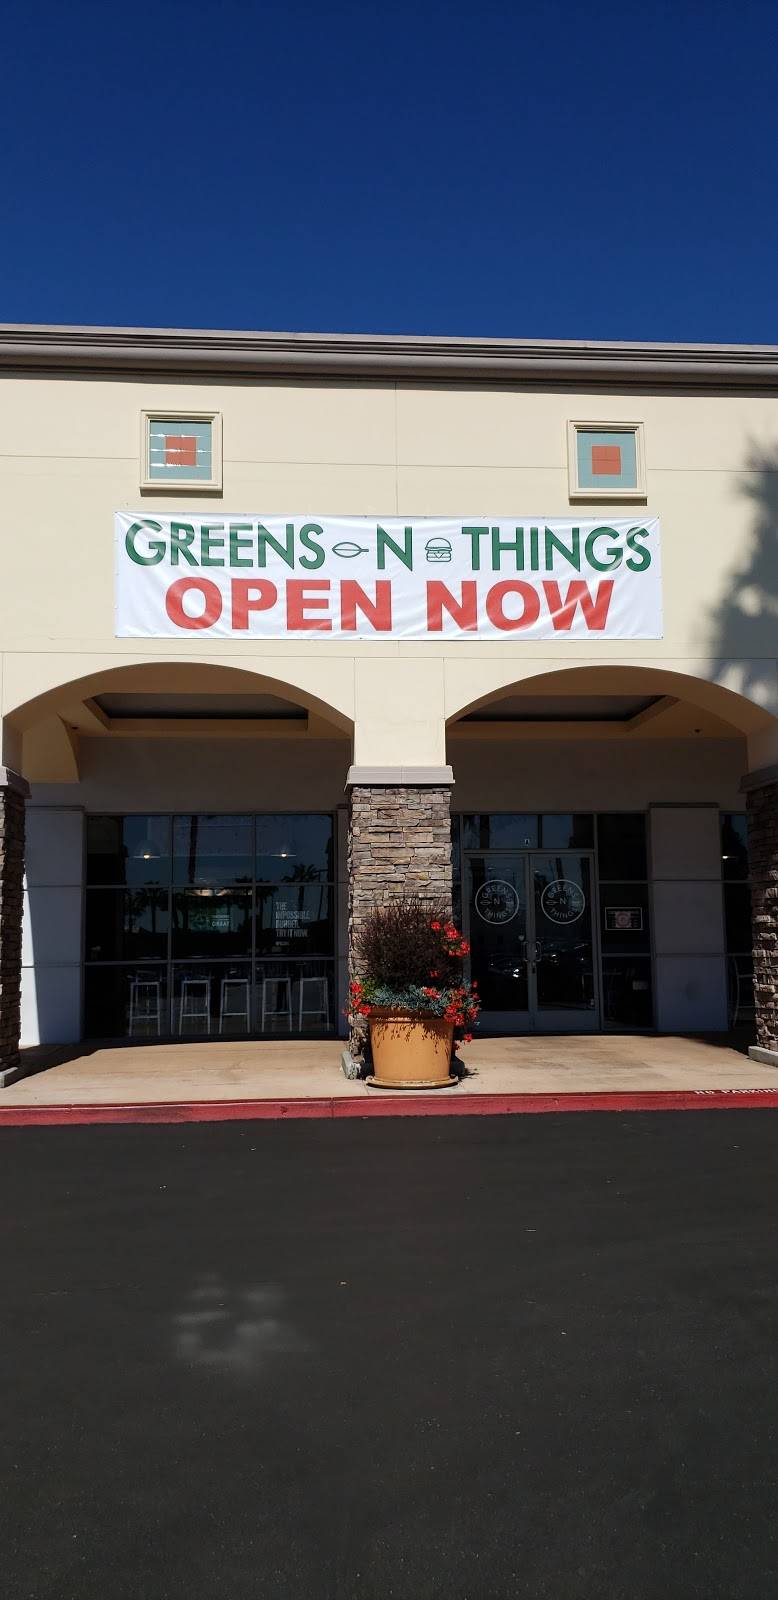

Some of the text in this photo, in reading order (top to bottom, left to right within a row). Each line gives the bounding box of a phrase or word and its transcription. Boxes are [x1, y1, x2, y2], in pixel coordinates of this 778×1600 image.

[124, 519, 652, 572] GREENS N THINGS
[165, 576, 615, 632] OPEN NOW
[275, 901, 288, 911] THE
